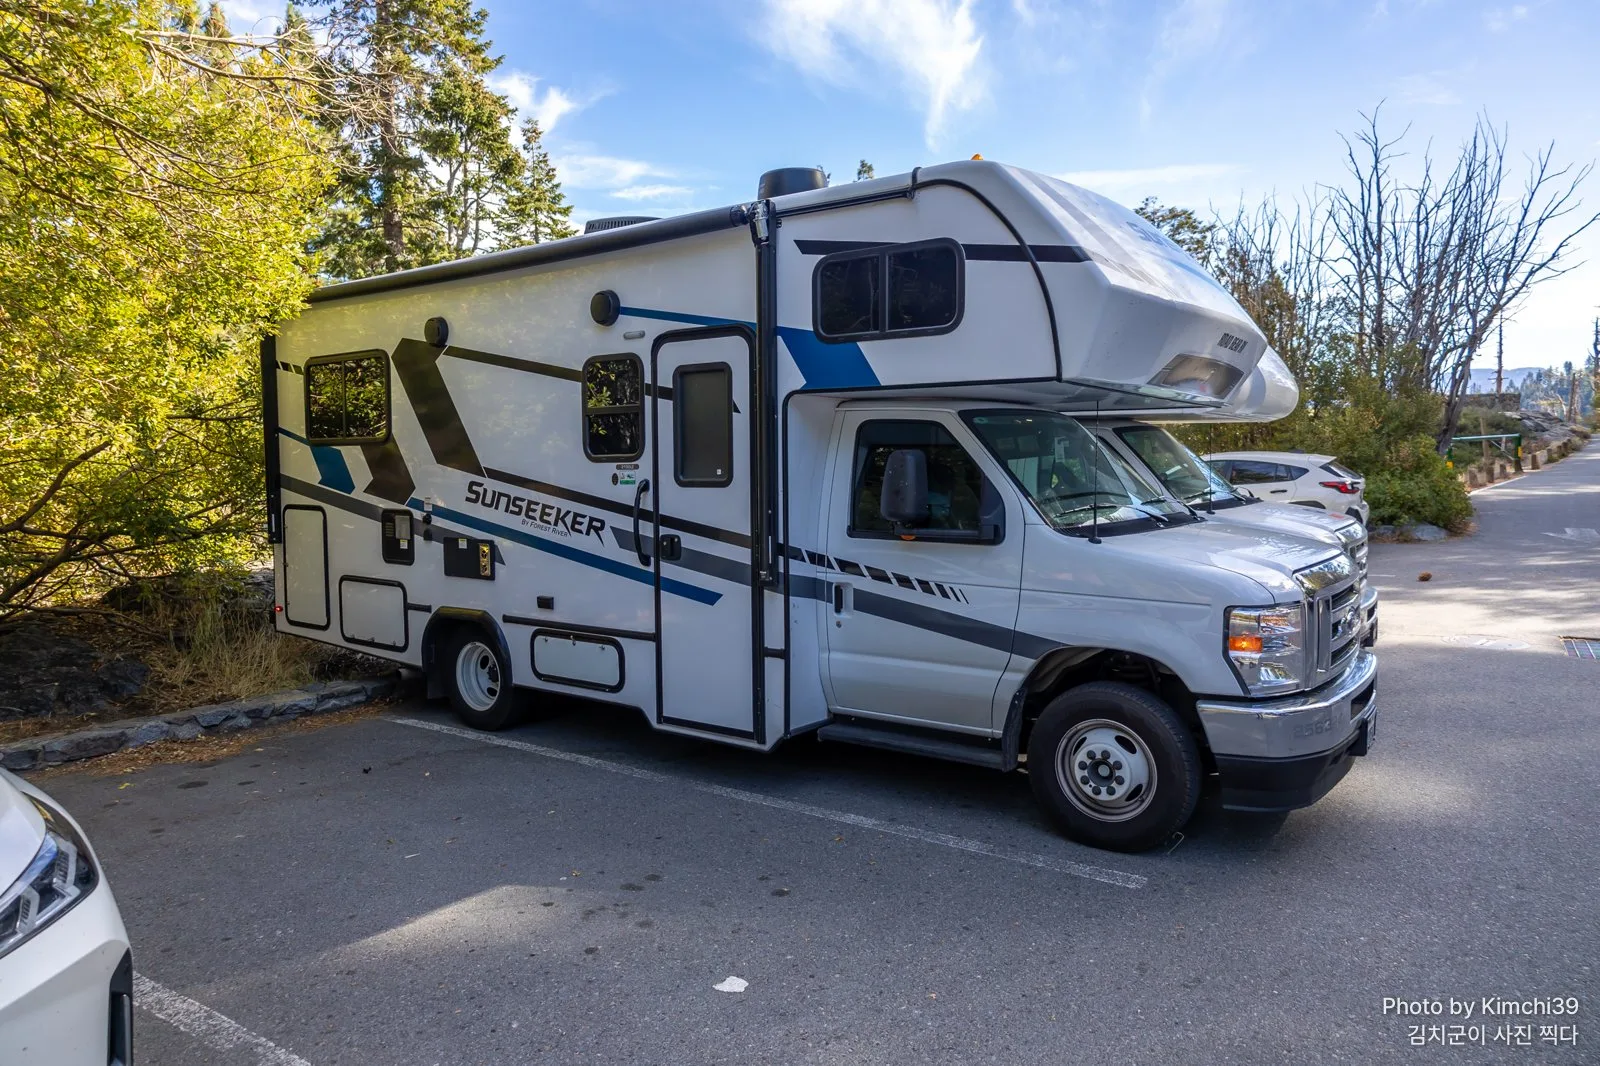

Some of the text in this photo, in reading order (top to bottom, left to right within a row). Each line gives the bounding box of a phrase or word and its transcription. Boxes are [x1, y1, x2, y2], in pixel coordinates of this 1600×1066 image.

[465, 480, 606, 547] SUNSEEKER
[530, 521, 551, 532] FOREST
[551, 527, 568, 537] RIVER
